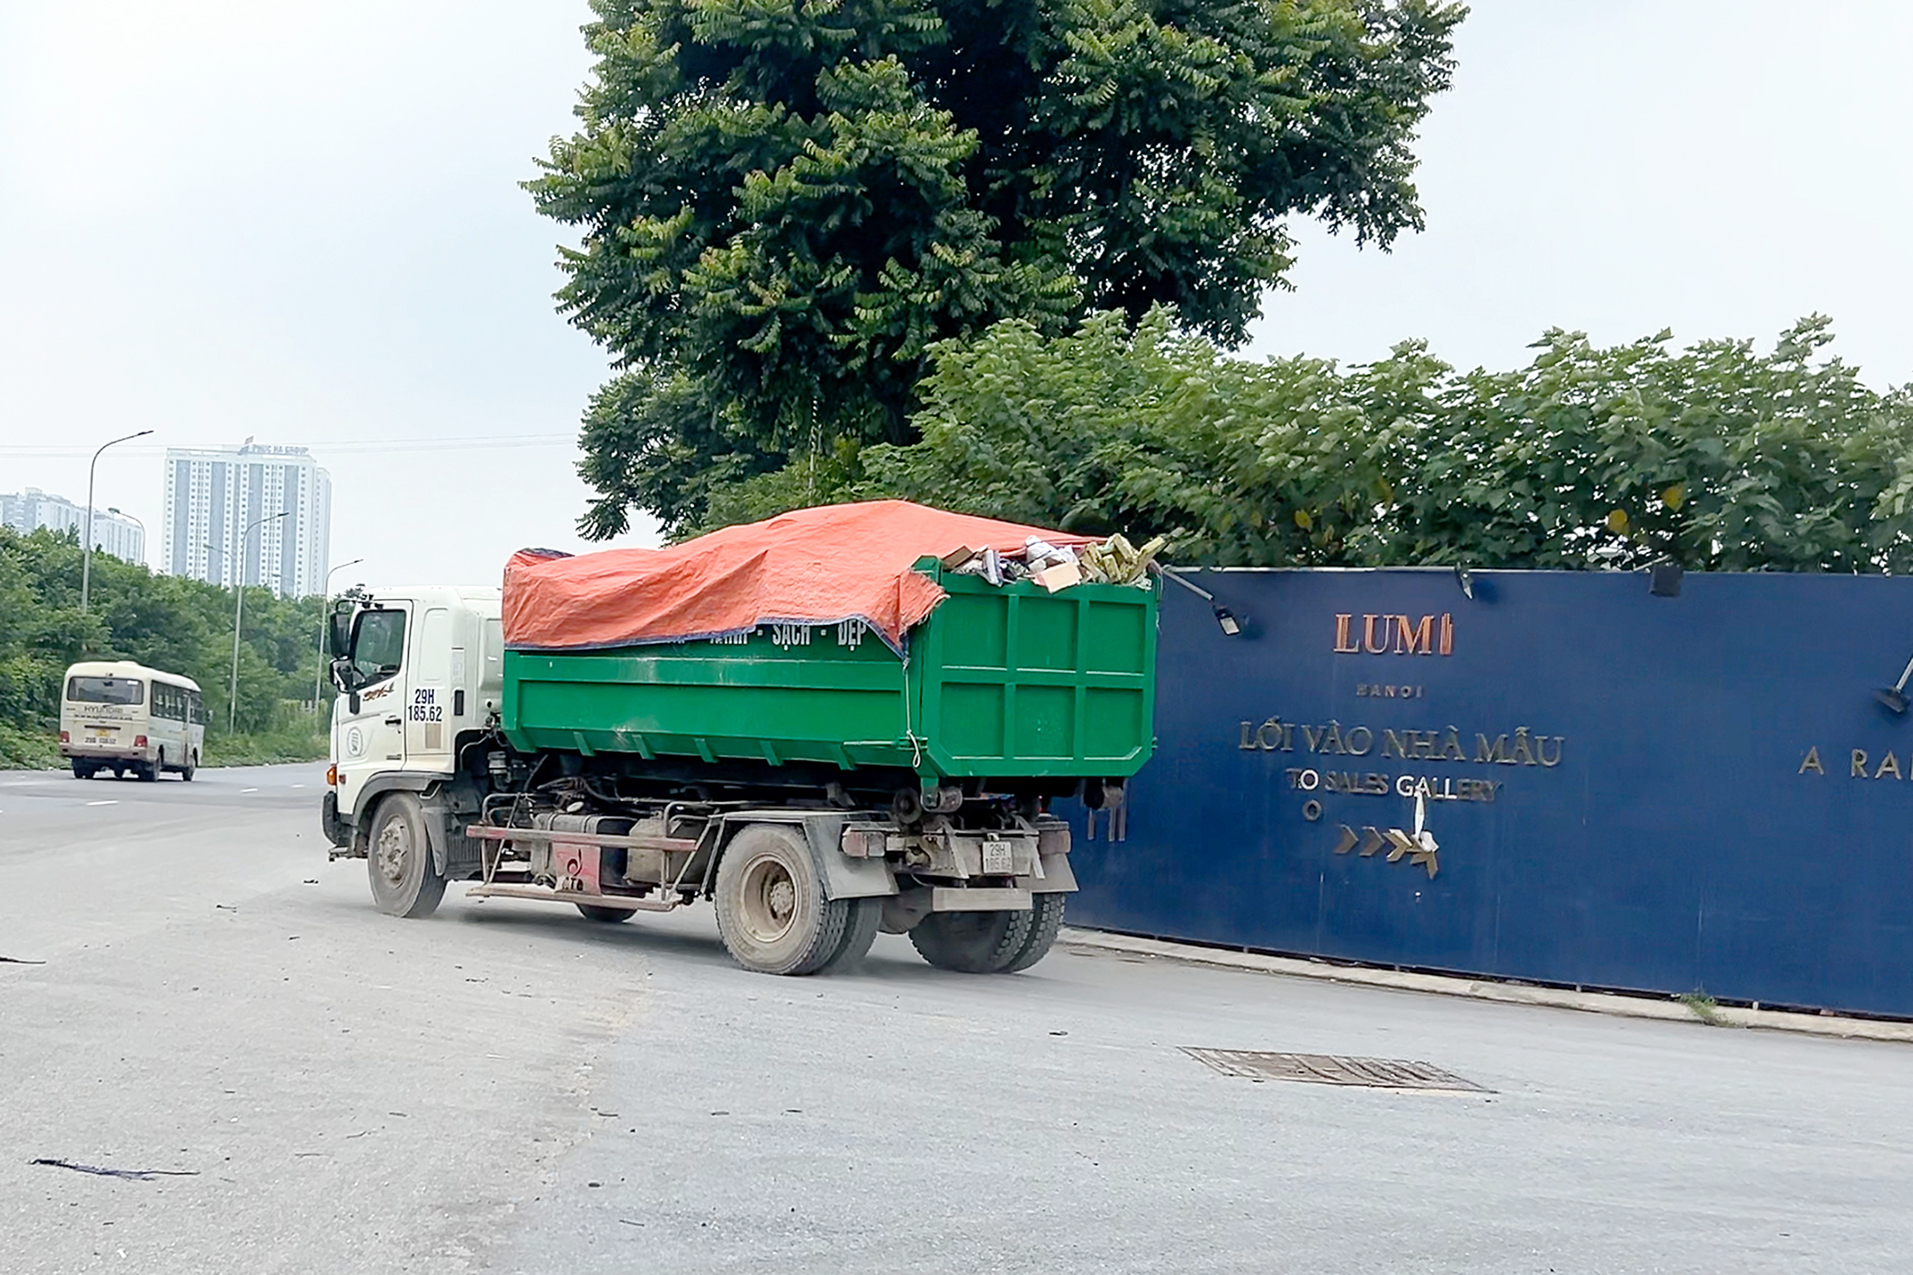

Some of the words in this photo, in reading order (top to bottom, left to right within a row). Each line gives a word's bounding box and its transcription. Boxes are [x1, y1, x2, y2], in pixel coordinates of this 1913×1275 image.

[1333, 613, 1453, 655] LUMI
[415, 688, 435, 704] 29H
[408, 705, 443, 722] 185.62
[1239, 716, 1295, 751] LỐI
[1301, 719, 1373, 755] VÀO
[1381, 725, 1467, 762] NHÀ
[1474, 726, 1566, 767] MẪU
[1286, 768, 1319, 790] TO
[1325, 770, 1390, 794] SALES
[1396, 775, 1502, 802] GALLERY
